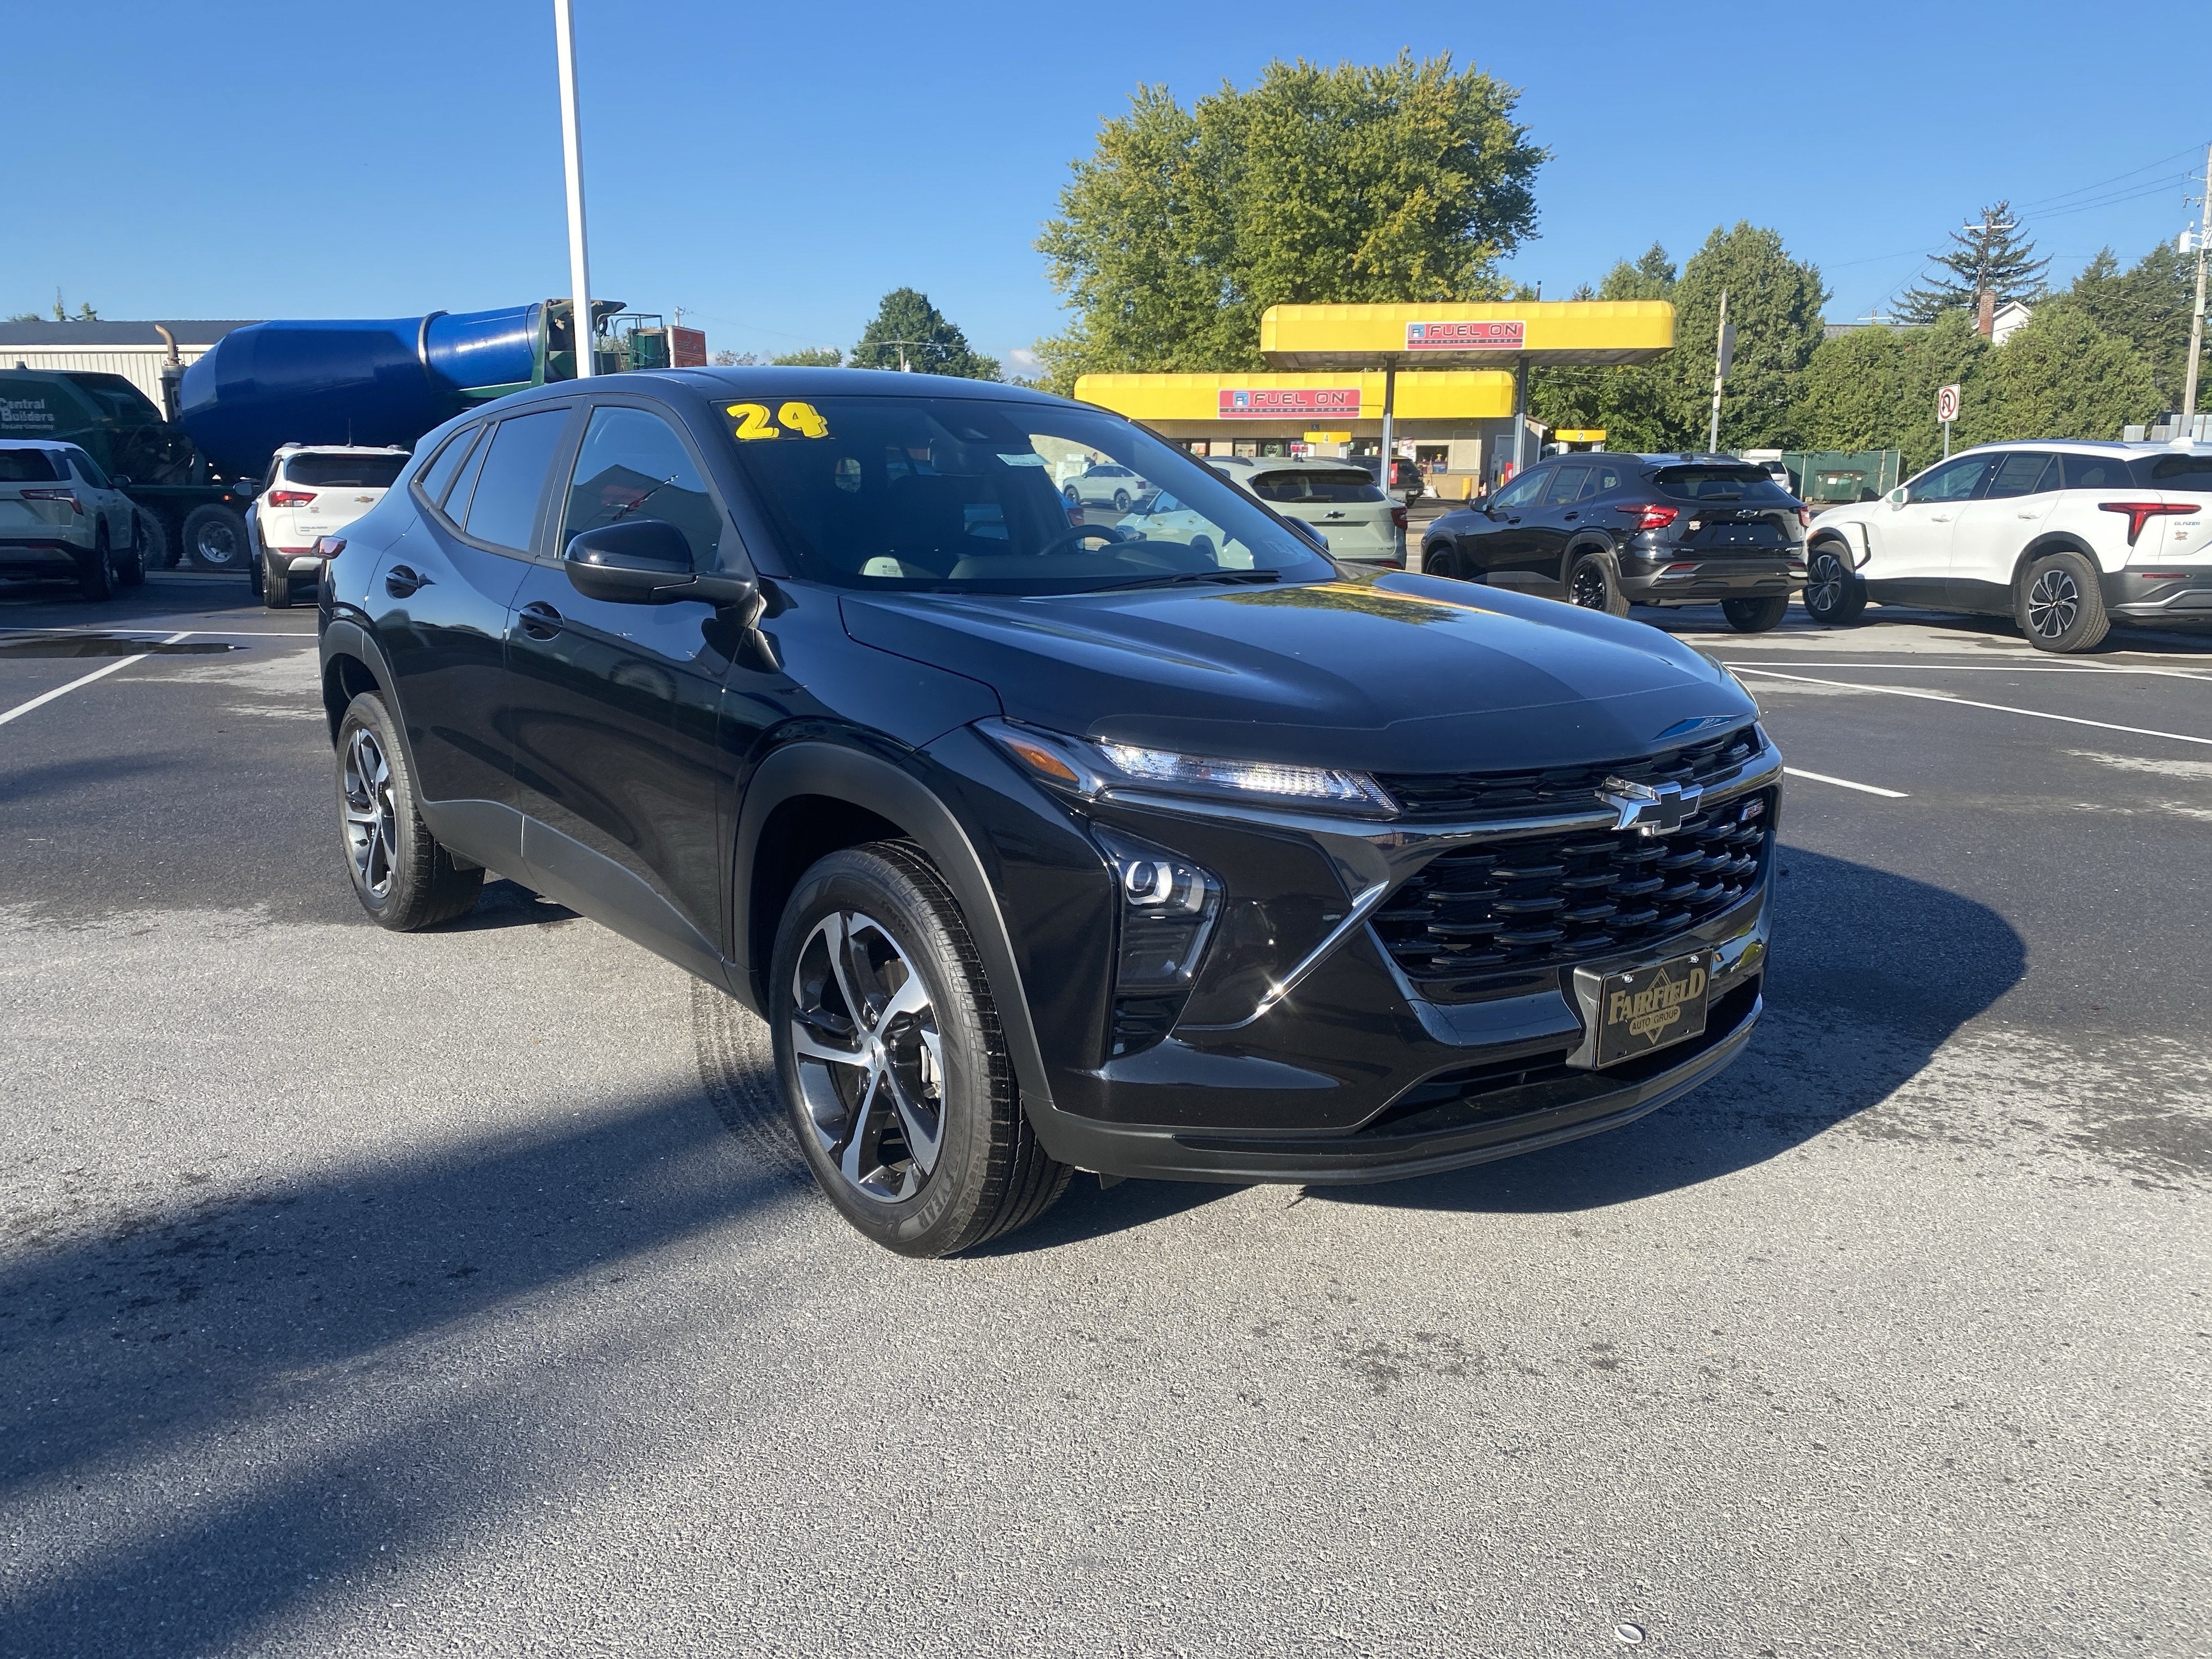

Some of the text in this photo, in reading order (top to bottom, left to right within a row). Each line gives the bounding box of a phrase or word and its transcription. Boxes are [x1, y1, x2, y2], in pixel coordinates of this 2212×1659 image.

[1430, 324, 1517, 336] FUEL ON
[1254, 392, 1345, 405] FUEL ON
[726, 402, 829, 439] 24
[1324, 435, 1329, 443] 4
[1579, 432, 1584, 441] 2
[1607, 968, 1706, 1025] FAIRFIELD
[1632, 1008, 1679, 1031] AUTO GROUP
